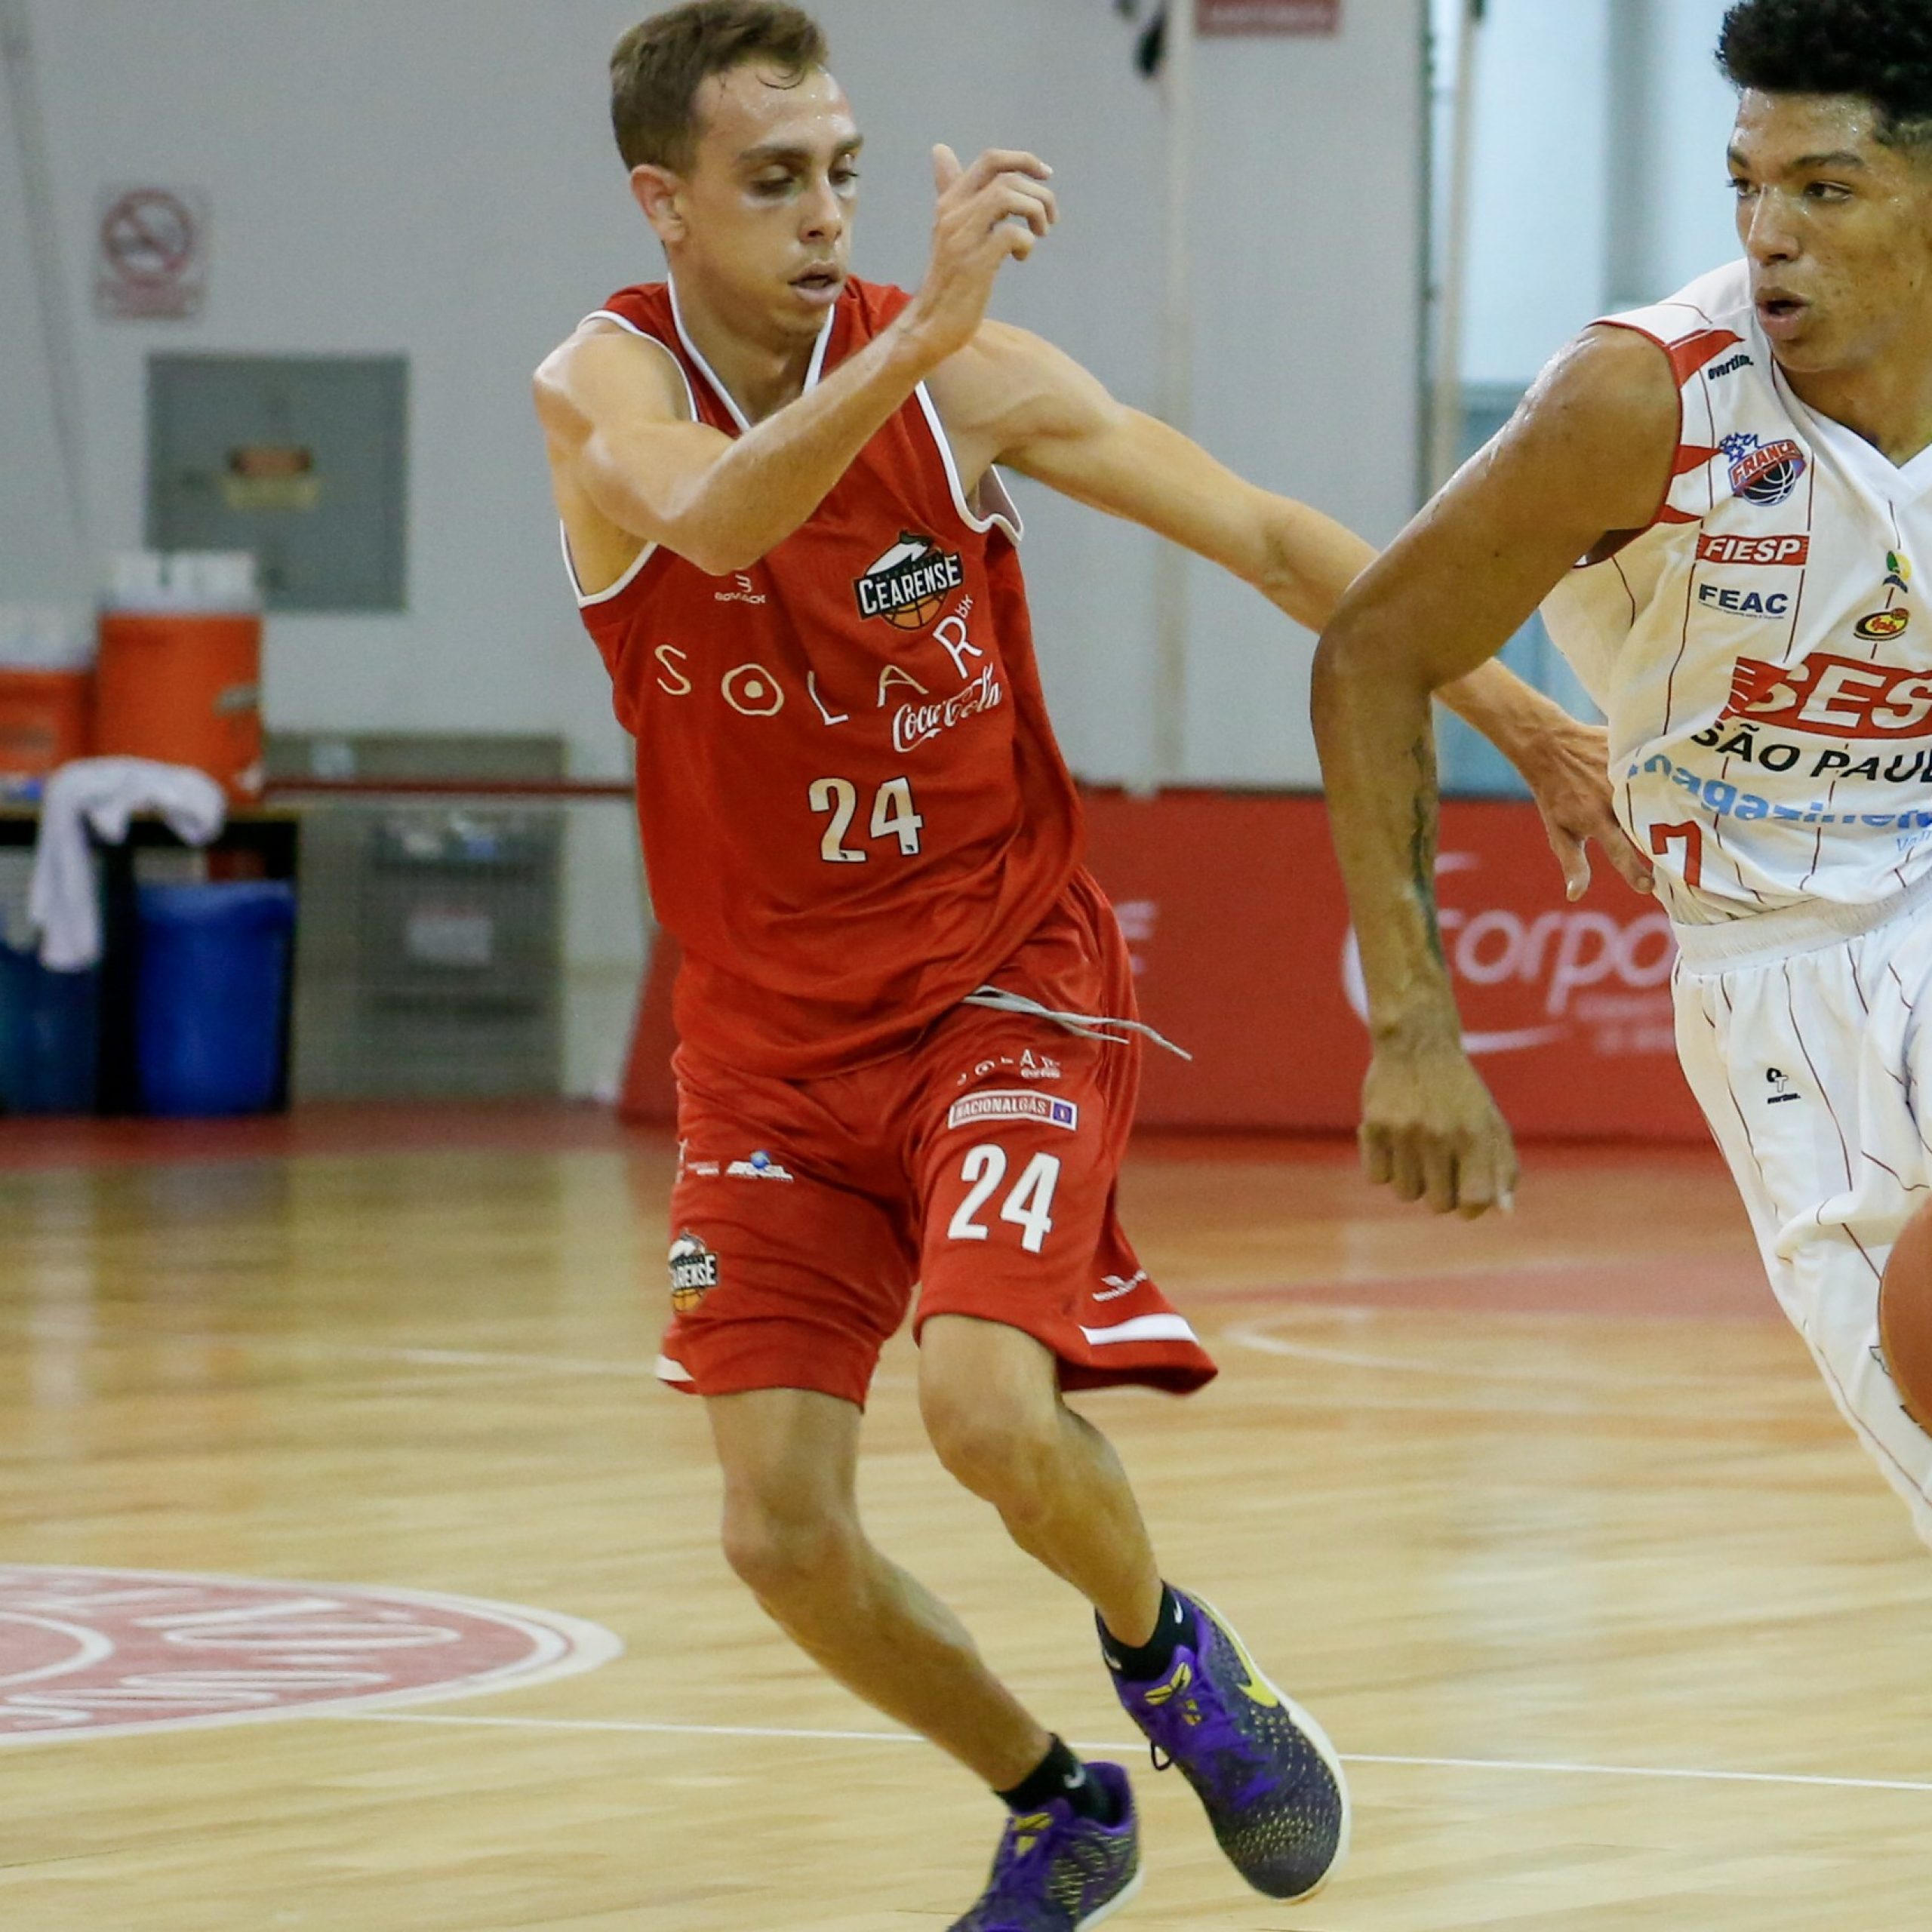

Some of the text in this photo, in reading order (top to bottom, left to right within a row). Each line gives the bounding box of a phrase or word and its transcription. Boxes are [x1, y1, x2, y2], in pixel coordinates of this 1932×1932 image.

[1704, 539, 1801, 562] FIESP
[859, 555, 962, 614] CEARENSE
[1699, 583, 1789, 614] FEAC
[1690, 723, 1801, 773] SÃO
[808, 777, 924, 863] 24
[1649, 820, 1703, 889] 7
[948, 1143, 1060, 1253] 24
